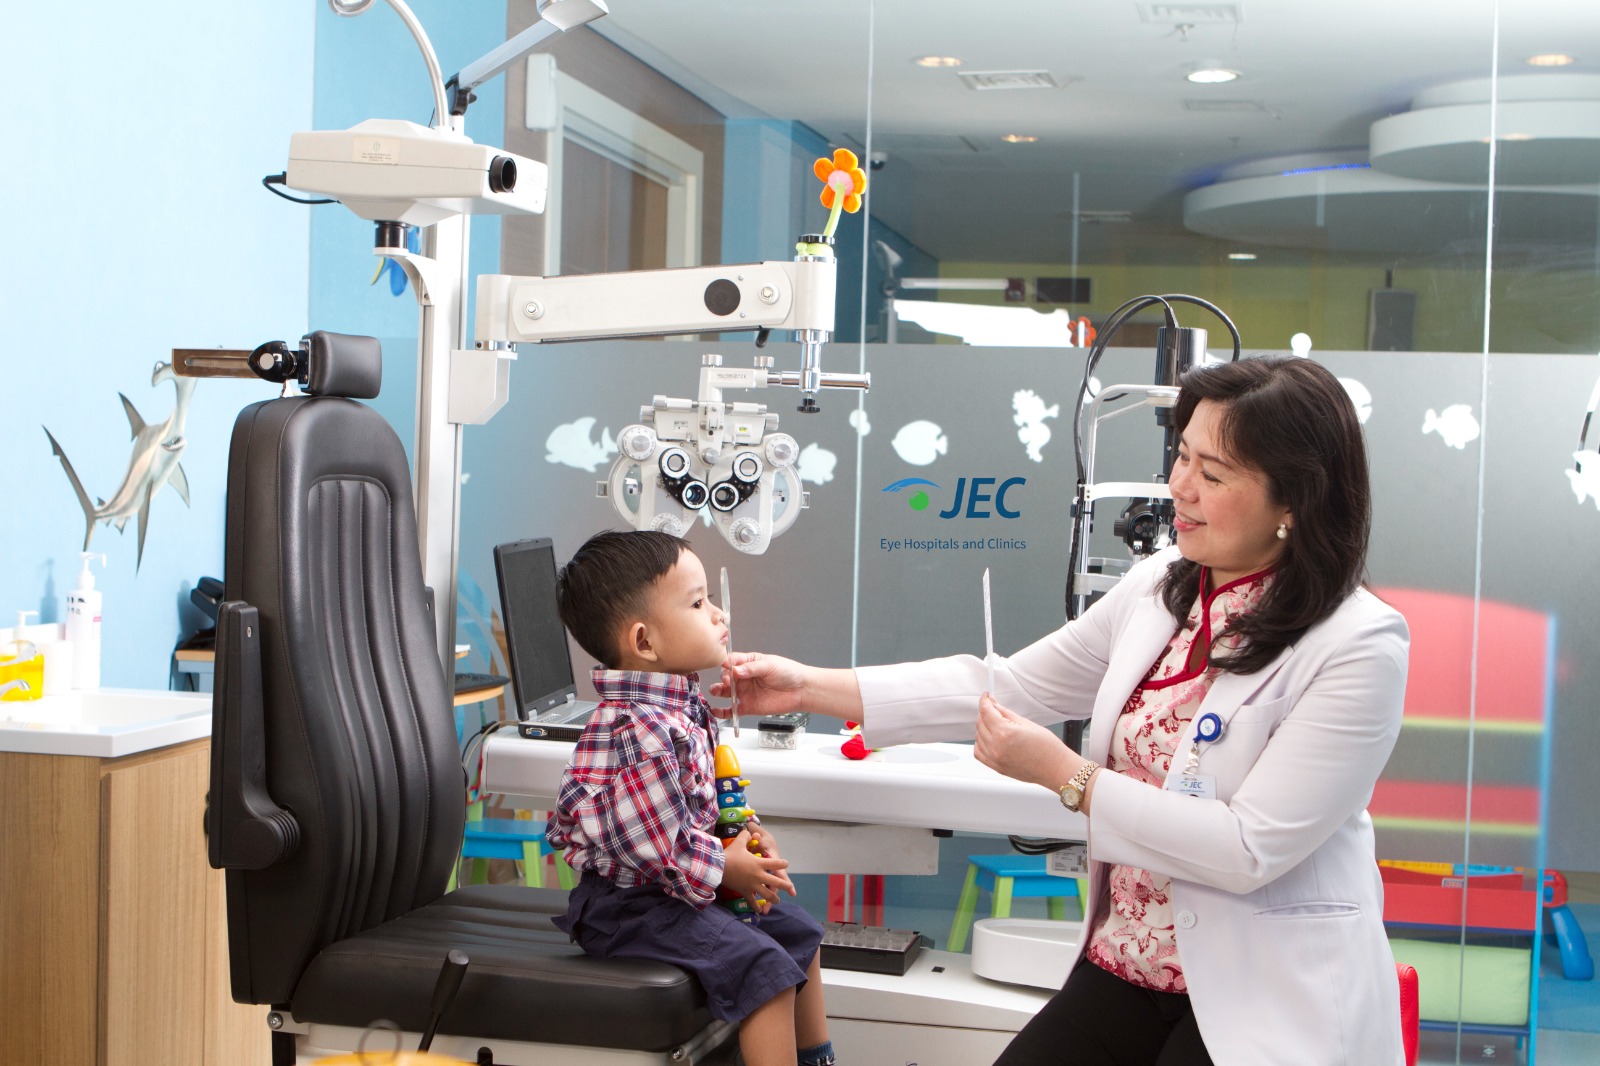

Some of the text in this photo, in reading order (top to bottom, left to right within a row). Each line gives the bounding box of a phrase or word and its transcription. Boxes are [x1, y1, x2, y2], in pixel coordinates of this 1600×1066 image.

[939, 477, 1026, 519] JEC
[880, 538, 1026, 551] Eye Hospitals and Clinics
